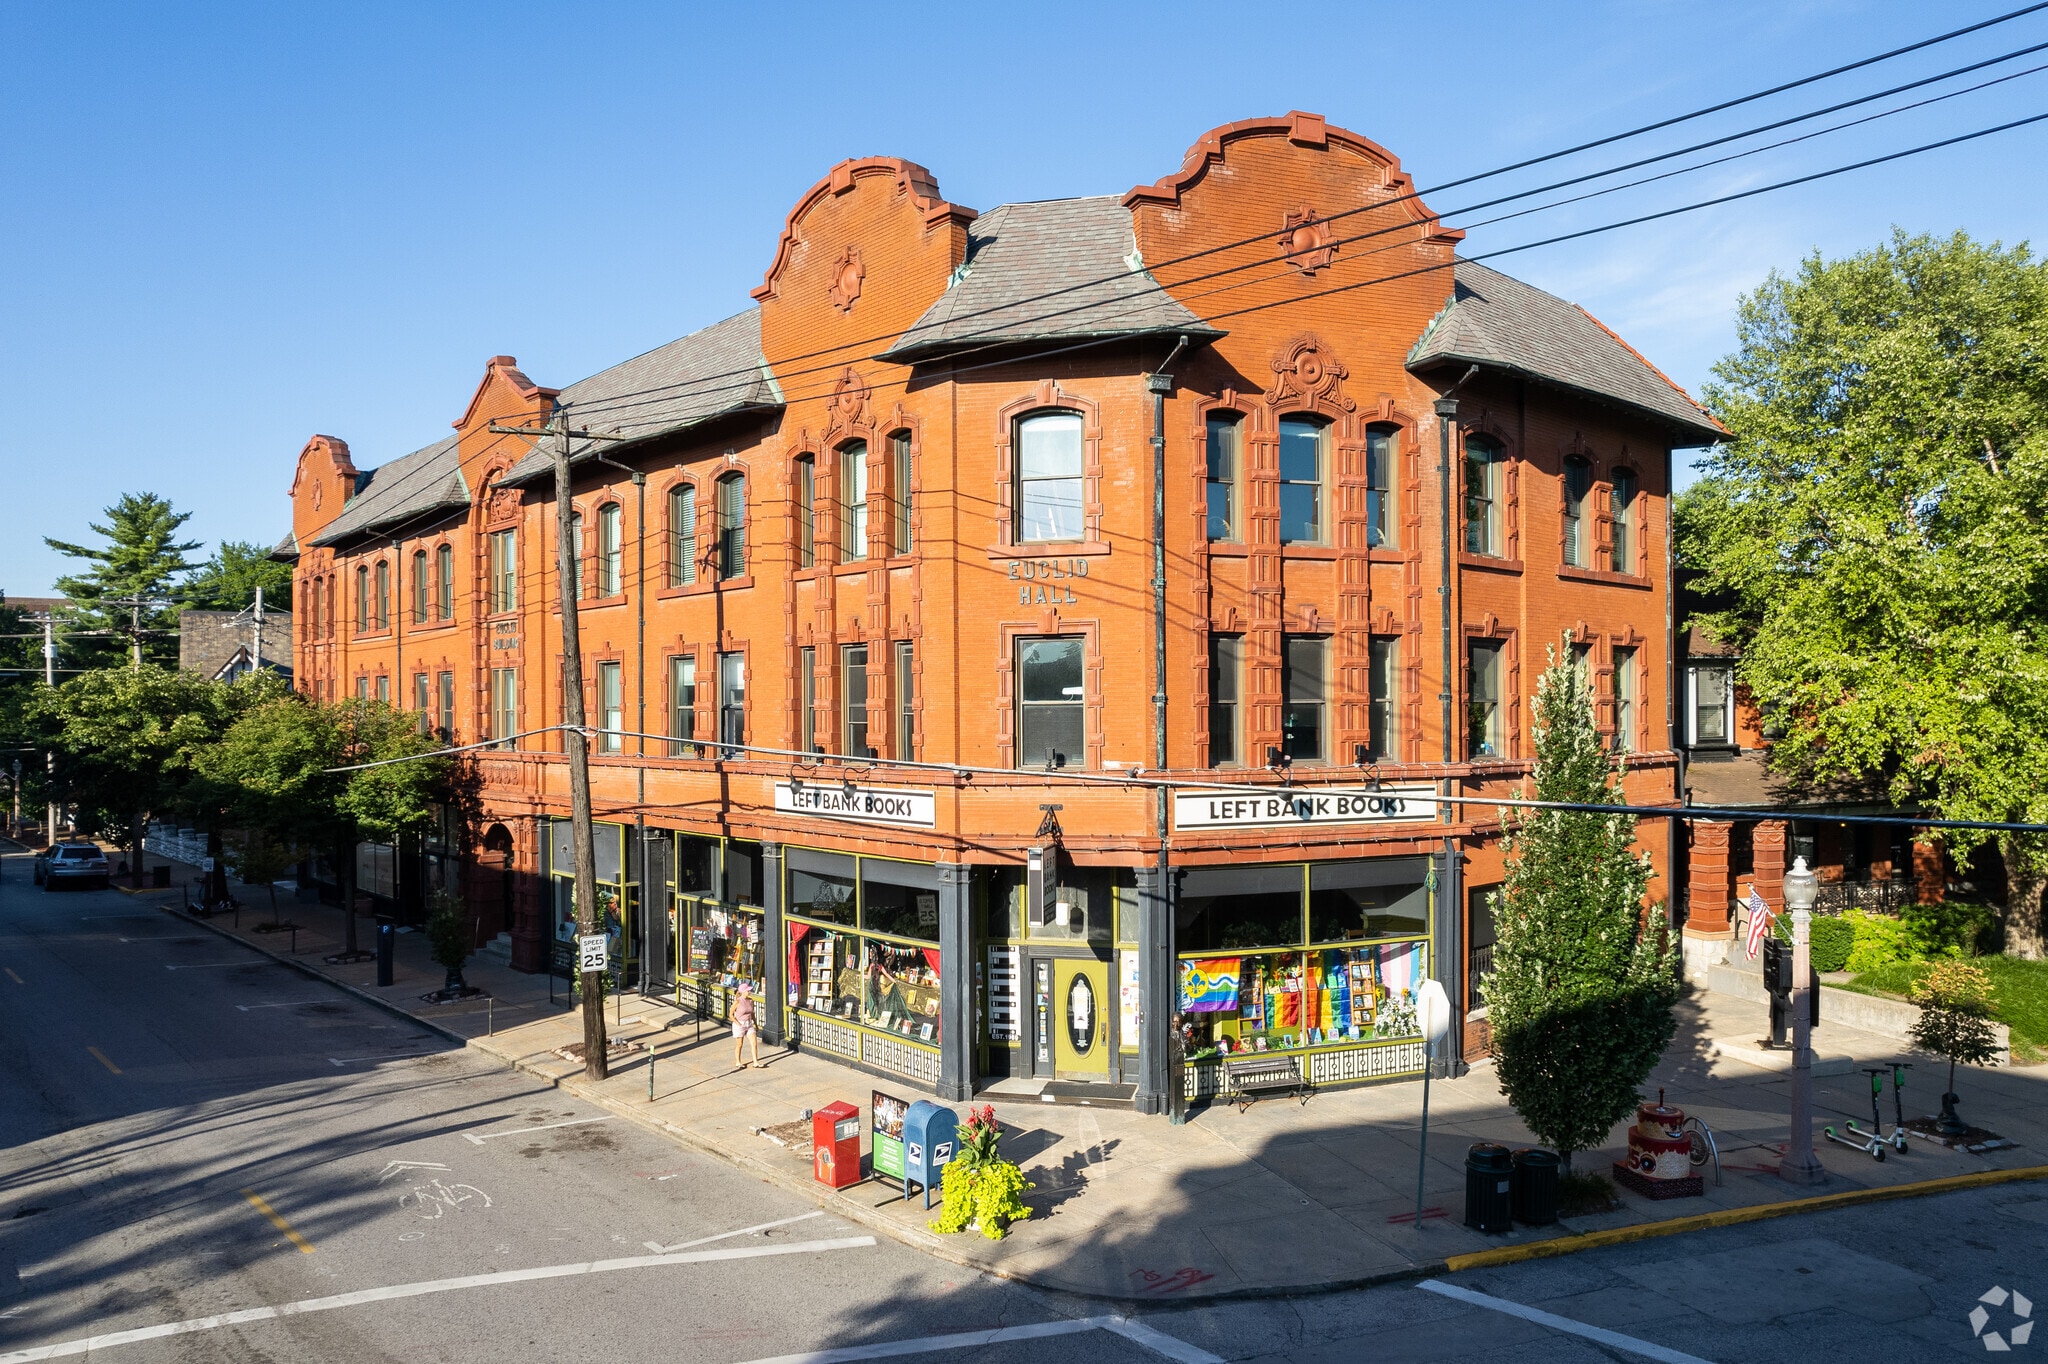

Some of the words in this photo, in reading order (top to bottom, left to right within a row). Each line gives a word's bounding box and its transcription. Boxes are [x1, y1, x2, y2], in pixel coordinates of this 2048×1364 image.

[1008, 558, 1088, 580] EUCLID
[1019, 584, 1077, 605] HALL
[792, 792, 821, 809] LEFT
[823, 793, 861, 812] BANK
[865, 796, 912, 816] BOOKS
[1210, 799, 1261, 819] LEFT
[1267, 798, 1329, 817] BANK
[1337, 796, 1406, 814] BOOKS
[583, 939, 604, 947] SPEED
[584, 953, 604, 967] 25
